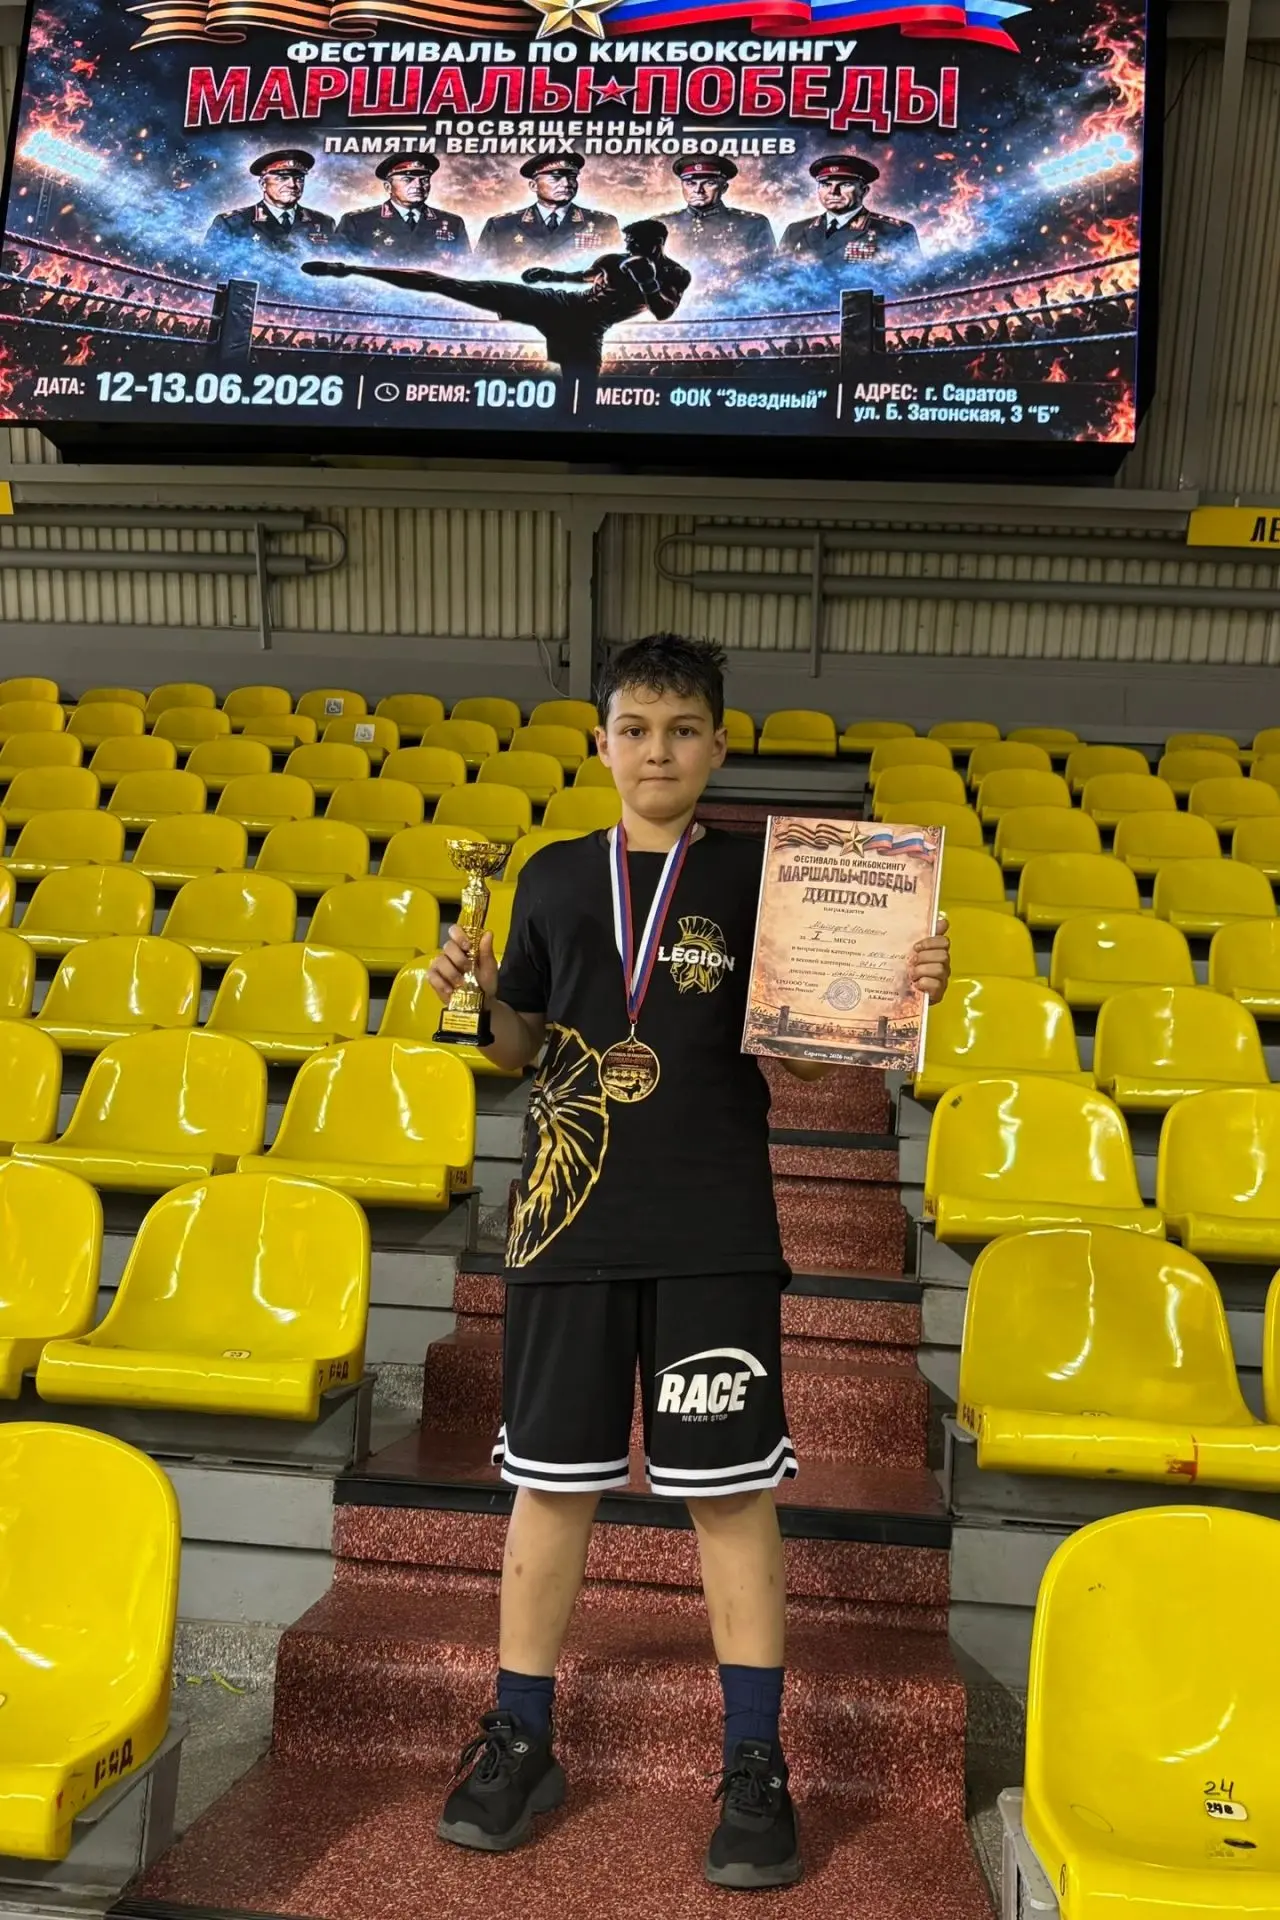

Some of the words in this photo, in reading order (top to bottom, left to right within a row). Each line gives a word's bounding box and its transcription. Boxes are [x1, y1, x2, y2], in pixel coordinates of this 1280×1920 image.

[287, 41, 517, 63] ФЕСТИВАЛЬ
[528, 41, 577, 62] ПО
[589, 40, 857, 62] КИКБОКСИНГУ
[184, 66, 595, 128] МАРШАЛЫ
[632, 65, 960, 133] ПОБЕДЫ
[435, 117, 674, 137] ПОСВЯЩЕННЫЙ
[324, 137, 438, 154] ПАМЯТИ
[446, 137, 575, 154] ВЕЛИКИХ
[584, 138, 797, 156] ПОЛКОВОДЦЕВ
[34, 377, 86, 397] ДАТА:
[96, 371, 343, 406] 12-13.06.2026
[405, 384, 471, 403] ВРЕМЯ:
[474, 379, 557, 408] 10:00
[596, 387, 661, 407] МЕСТО:
[669, 386, 712, 407] ФОК
[853, 383, 918, 403] АДРЕС:
[924, 386, 938, 402] г.
[942, 383, 1018, 405] Саратов
[853, 405, 880, 423] ул.
[885, 403, 903, 421] Б.
[907, 403, 1006, 425] Затонская,
[1009, 406, 1023, 423] 3
[793, 854, 838, 866] ФЕСТИВАЛЬ
[839, 857, 851, 867] ПО
[851, 859, 907, 872] КИКБОКСИНГУ
[777, 864, 853, 883] МАРШАЛЫ
[859, 869, 919, 894] ПОБЕДЫ
[801, 886, 889, 909] ДИПЛОМ
[833, 937, 857, 945] МЕСТО
[657, 945, 736, 972] LEGION
[657, 1371, 751, 1414] RACE
[681, 1414, 708, 1423] NEVER
[710, 1413, 728, 1422] STOP
[1203, 1778, 1234, 1800] 24
